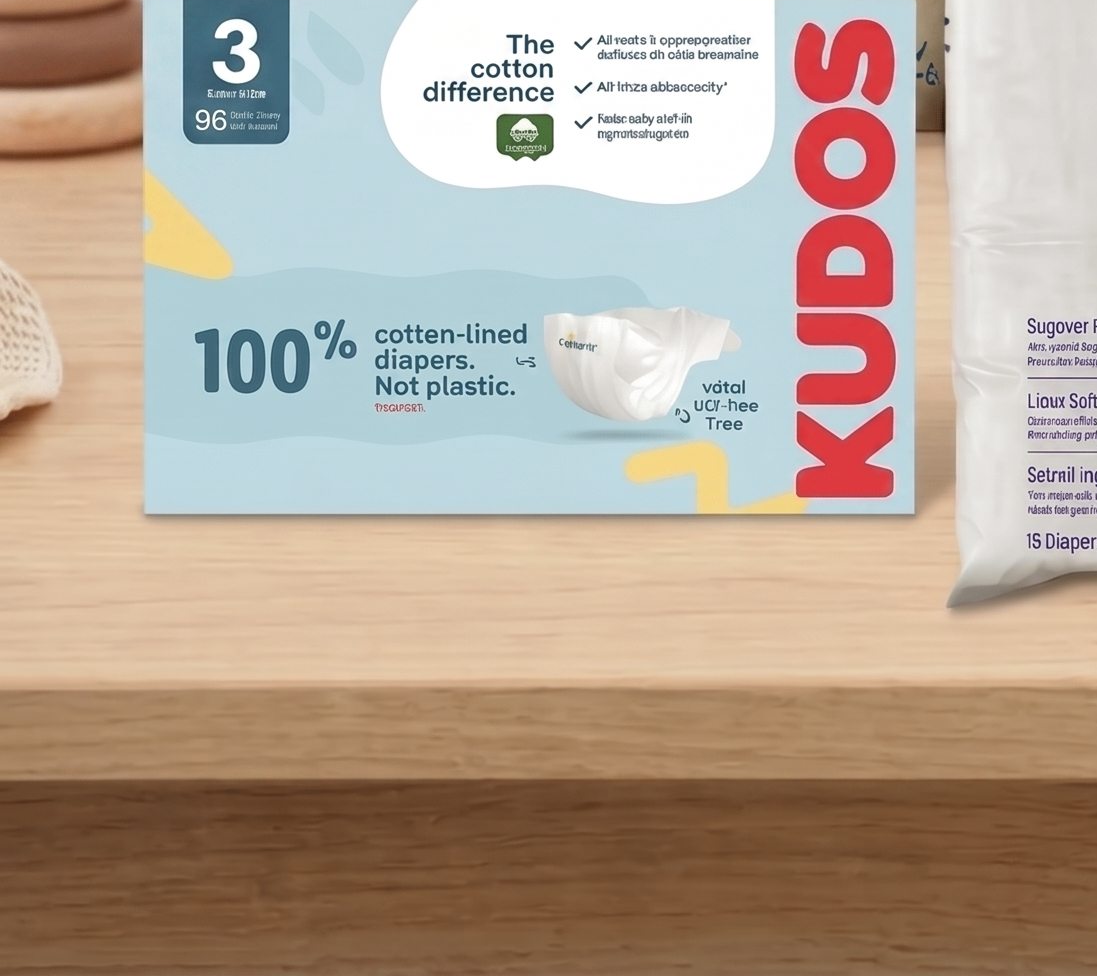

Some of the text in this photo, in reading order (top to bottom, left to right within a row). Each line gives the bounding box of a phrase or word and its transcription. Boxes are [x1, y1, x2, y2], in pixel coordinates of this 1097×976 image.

[212, 18, 261, 84] 3
[506, 34, 555, 55] The
[470, 59, 555, 79] cotton
[423, 81, 555, 103] difference
[195, 109, 227, 131] 96
[794, 18, 897, 499] KUDOS
[374, 323, 528, 345] cotten-lined
[1027, 317, 1090, 339] Sugover
[194, 319, 358, 395] 100%
[374, 348, 476, 374] diapers.
[375, 375, 517, 401] Not plastic.
[705, 416, 744, 431] Tree
